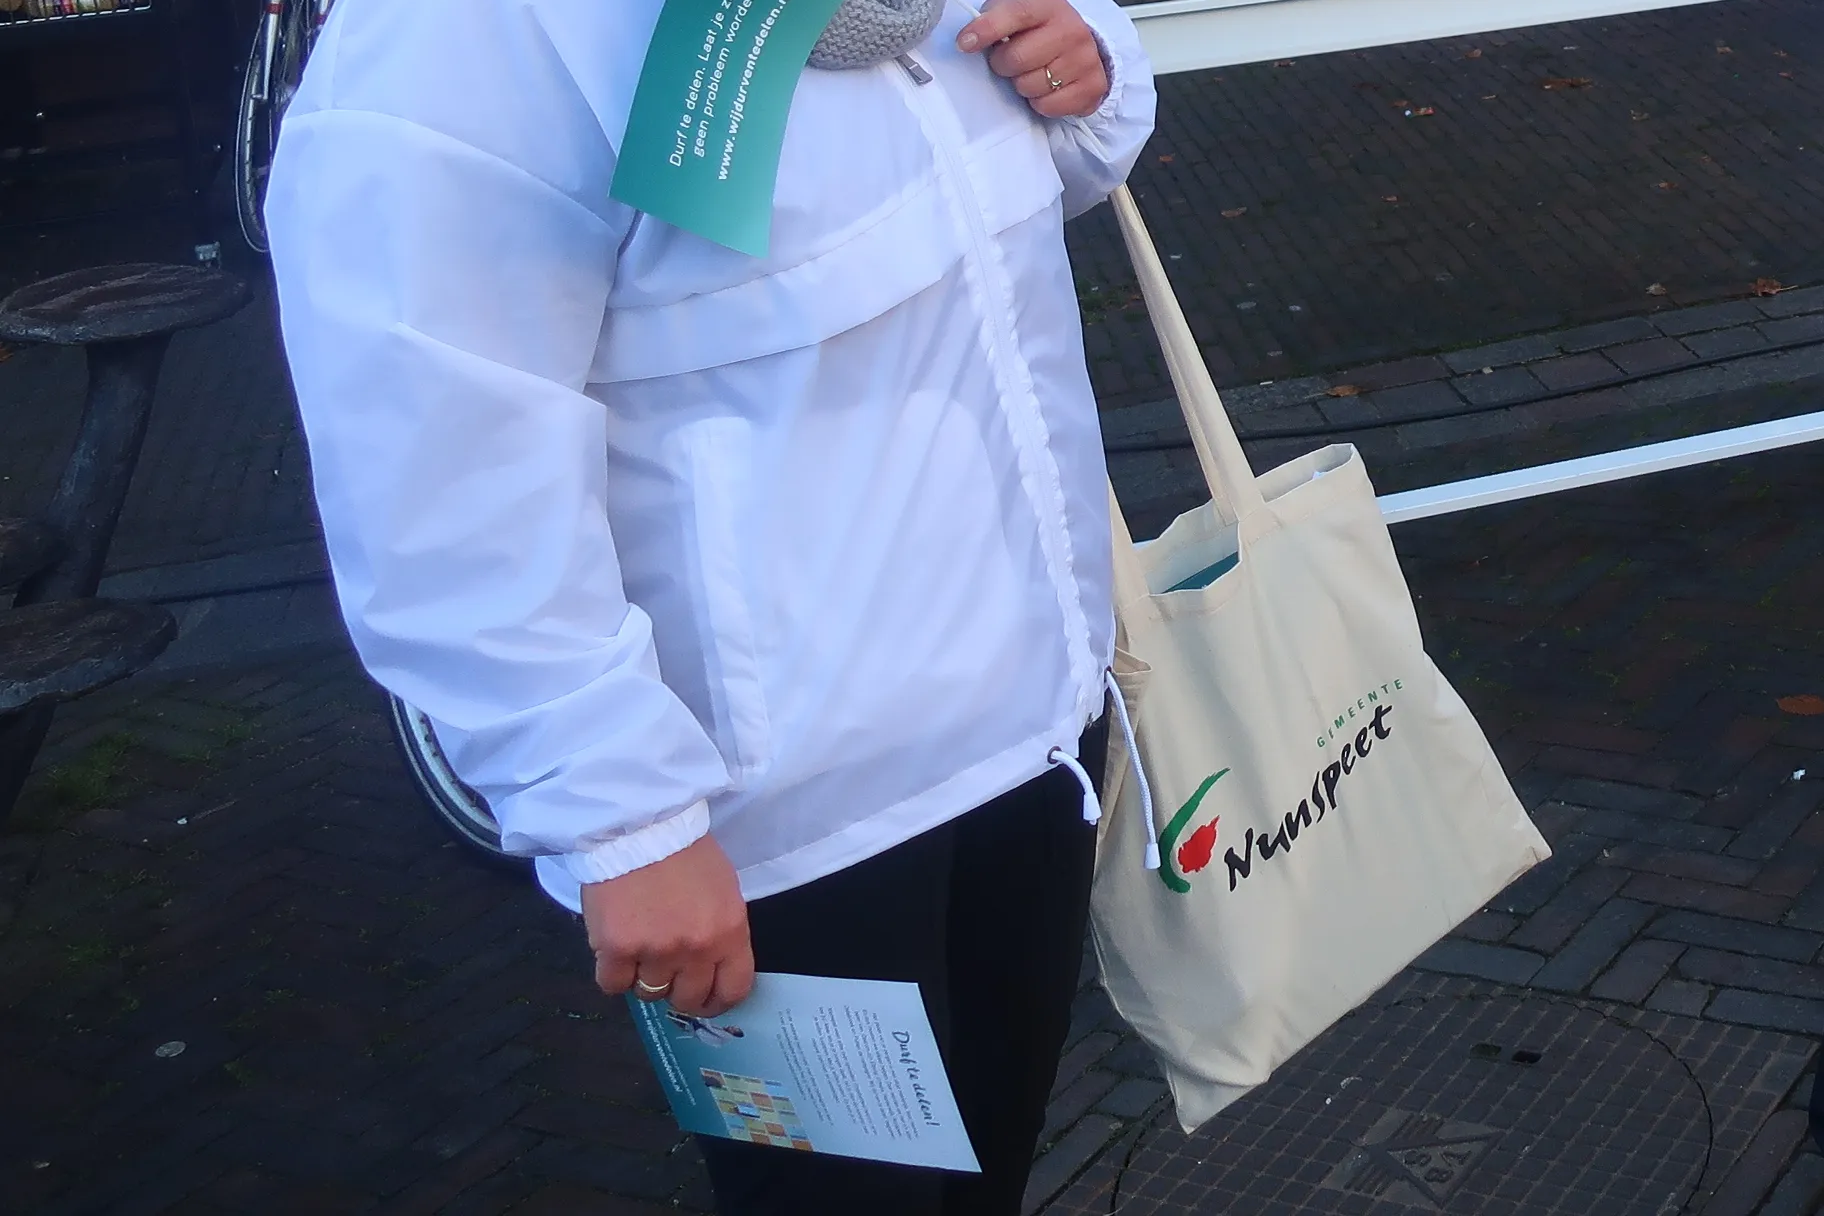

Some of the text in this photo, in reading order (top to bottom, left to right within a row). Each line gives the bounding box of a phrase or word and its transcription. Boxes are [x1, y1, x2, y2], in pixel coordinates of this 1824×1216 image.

[710, 12, 725, 30] je
[697, 29, 718, 62] Laat
[684, 67, 706, 110] delen.
[694, 119, 709, 158] geen
[703, 47, 731, 118] probleem
[679, 114, 692, 129] te
[669, 130, 688, 167] Durf
[1223, 704, 1393, 893] Nunspeet
[892, 1030, 941, 1126] Durf te delen!
